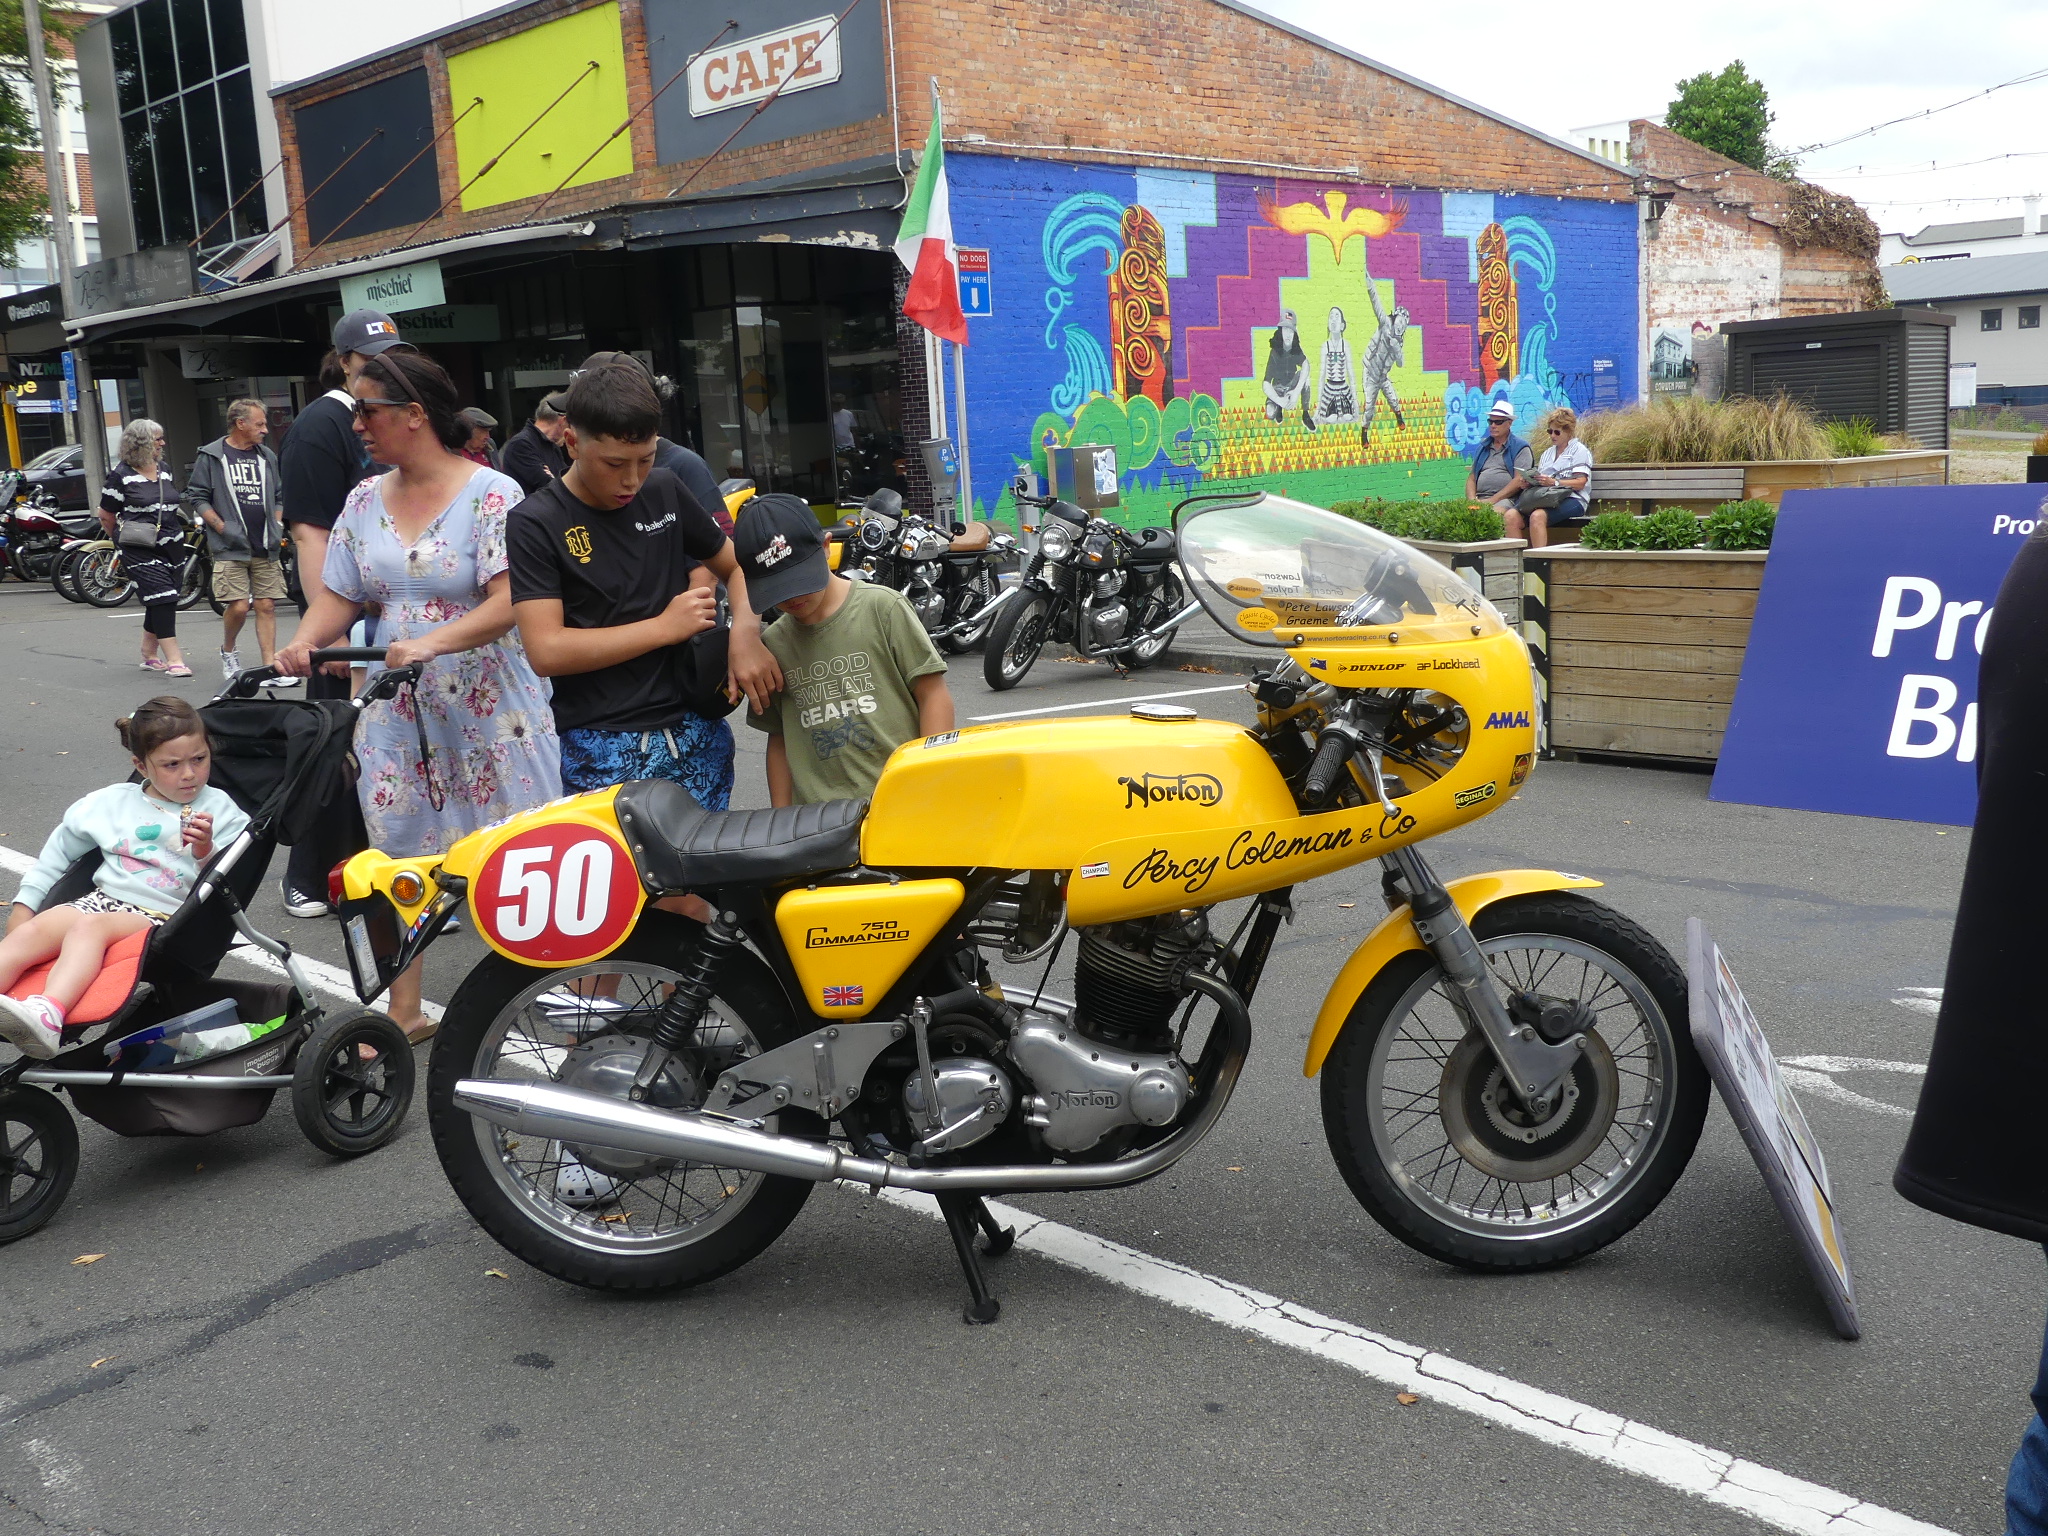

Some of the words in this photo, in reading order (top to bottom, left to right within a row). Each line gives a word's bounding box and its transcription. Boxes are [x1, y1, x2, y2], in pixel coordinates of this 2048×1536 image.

[704, 30, 822, 102] CAFE
[970, 255, 986, 263] DOGS
[135, 263, 168, 286] SALON
[366, 273, 412, 301] mischief
[384, 299, 399, 307] CAFE
[392, 311, 455, 329] ischief
[234, 485, 260, 494] MPANY
[765, 545, 792, 568] RACING
[1285, 602, 1310, 612] Pete
[1315, 602, 1355, 612] Lawson
[1286, 616, 1329, 625] Graeme
[1335, 615, 1370, 627] Taylor
[1306, 634, 1387, 642] www.nortonracing.co.nz
[784, 651, 870, 690] BLOOD
[1348, 663, 1404, 672] DUNLOP
[1433, 658, 1480, 670] Lockheed
[794, 673, 872, 708] SWEAT
[800, 695, 877, 728] GEARS
[1483, 711, 1530, 729] AMAL
[1118, 772, 1223, 809] Norton
[1456, 790, 1483, 804] REGINA
[1123, 848, 1221, 893] Percy
[1226, 830, 1353, 870] Coleman
[1360, 827, 1373, 843] &
[1379, 807, 1417, 839] Co
[1082, 866, 1109, 875] CHAMPION
[496, 839, 613, 942] 50
[861, 920, 898, 931] 750
[805, 927, 909, 949] COMMANDO
[247, 1048, 279, 1067] mountain
[1051, 1089, 1122, 1111] Norton
